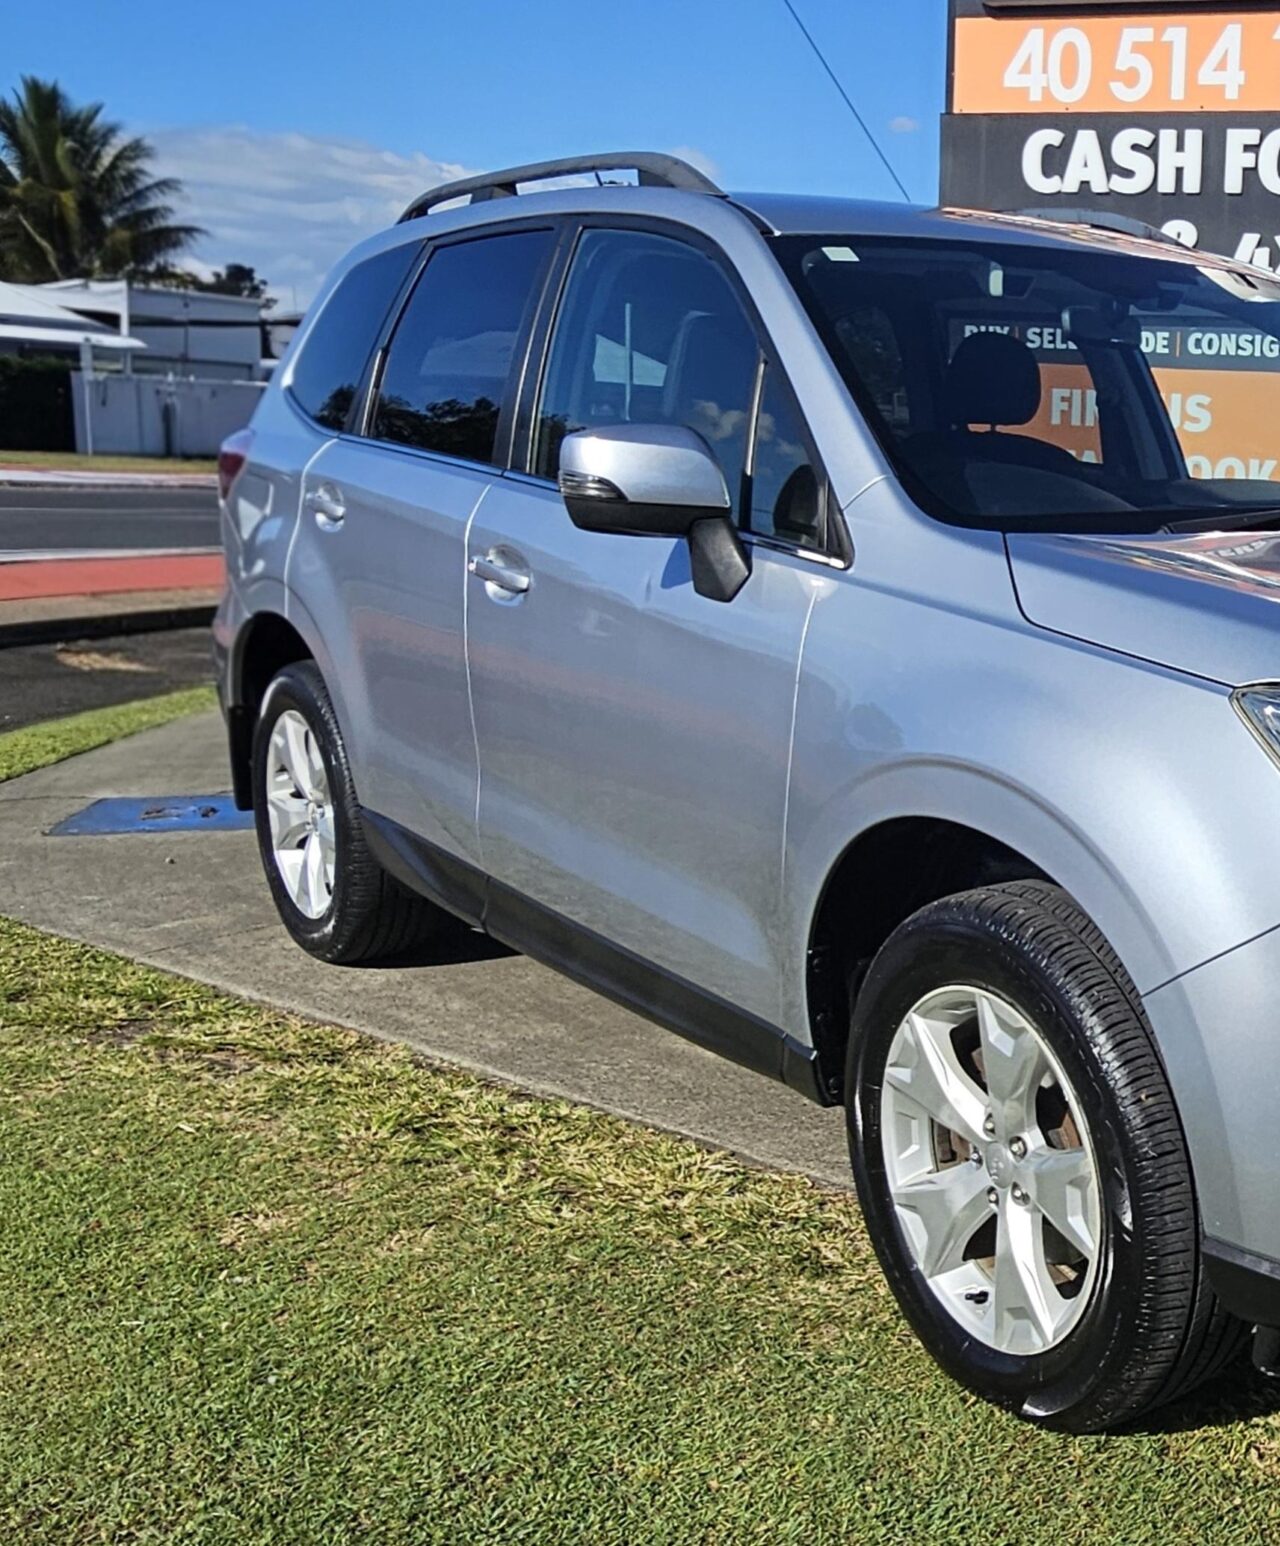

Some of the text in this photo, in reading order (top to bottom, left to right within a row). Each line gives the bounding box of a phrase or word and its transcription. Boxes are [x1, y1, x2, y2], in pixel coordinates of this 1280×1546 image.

[1003, 27, 1092, 103] 40
[1109, 23, 1245, 101] 514
[1021, 127, 1203, 194] CASH
